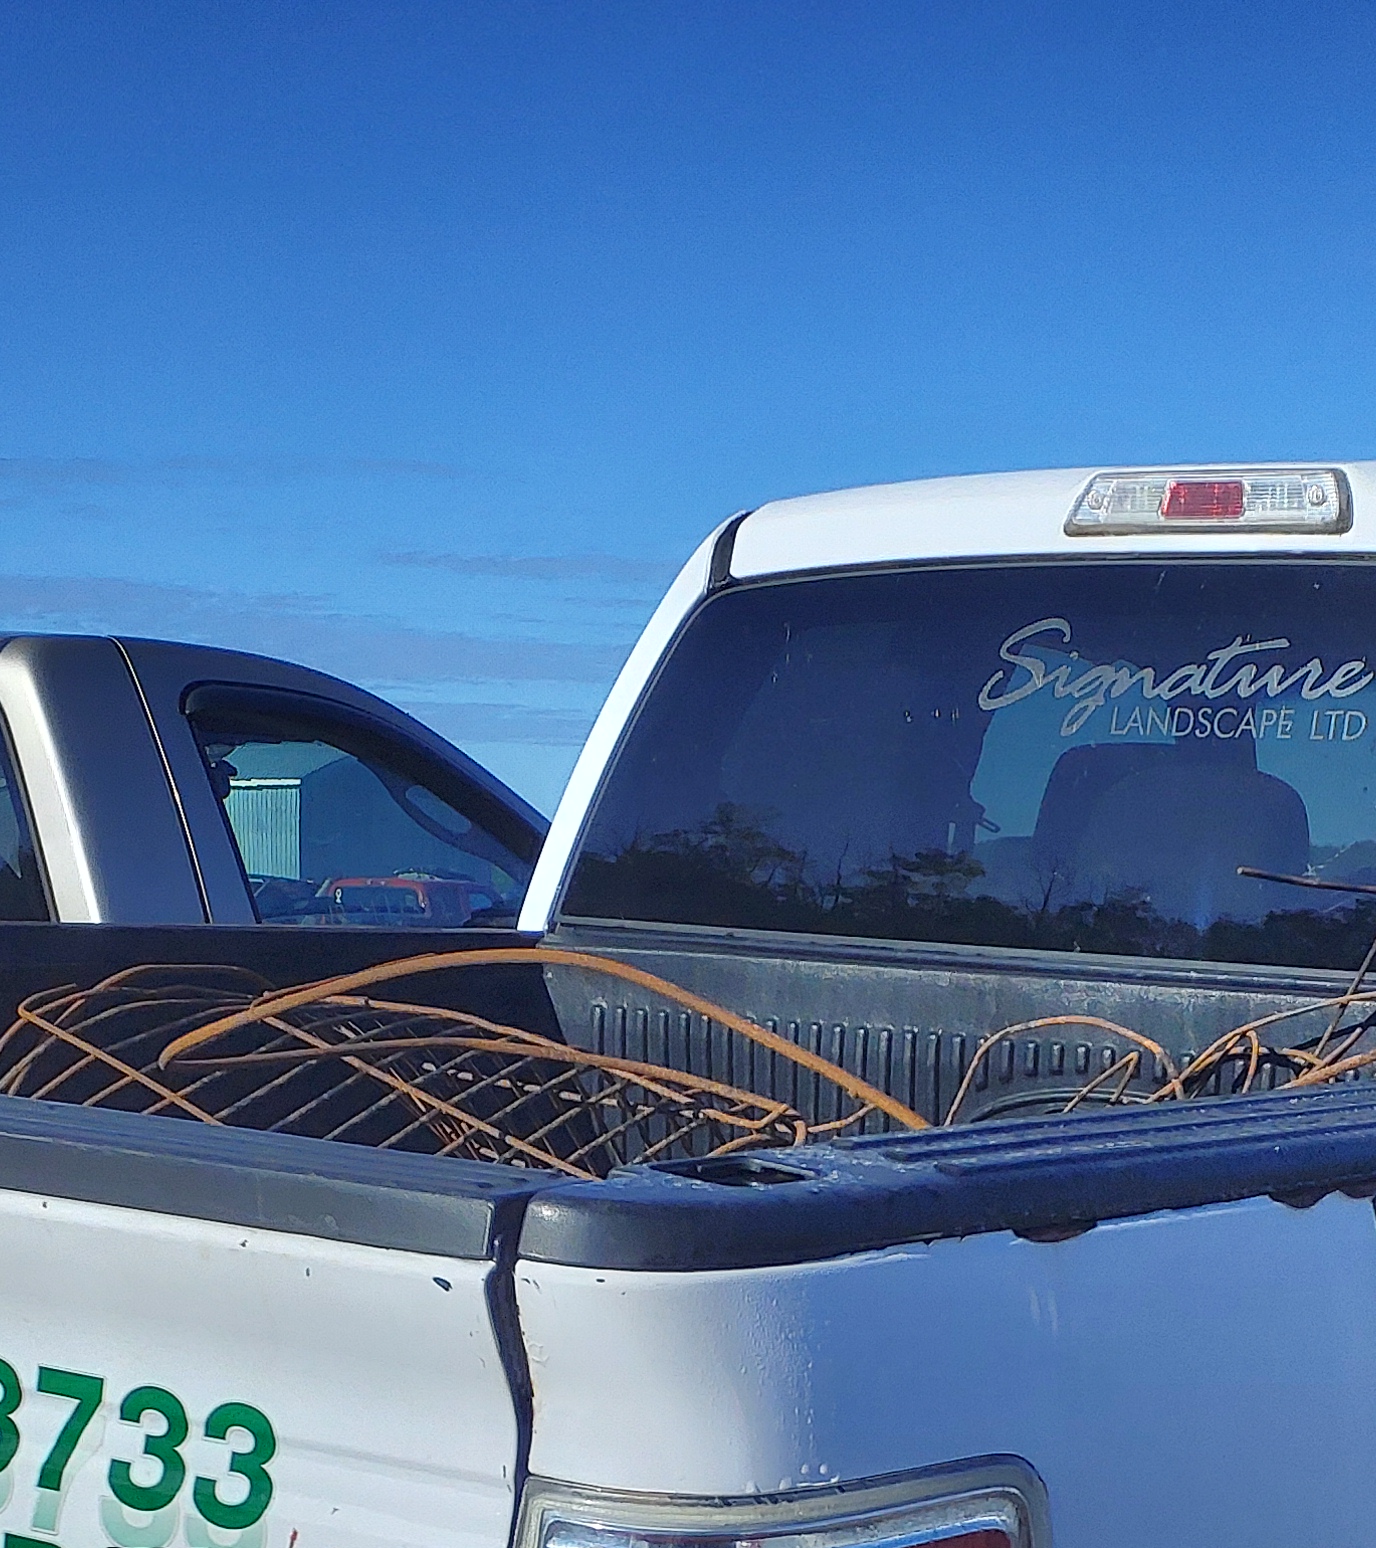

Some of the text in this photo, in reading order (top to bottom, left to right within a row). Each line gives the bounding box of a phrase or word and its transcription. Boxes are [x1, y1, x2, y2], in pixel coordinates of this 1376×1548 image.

[978, 617, 1375, 737] Signature
[1109, 705, 1368, 741] LANDSCAPE LTD
